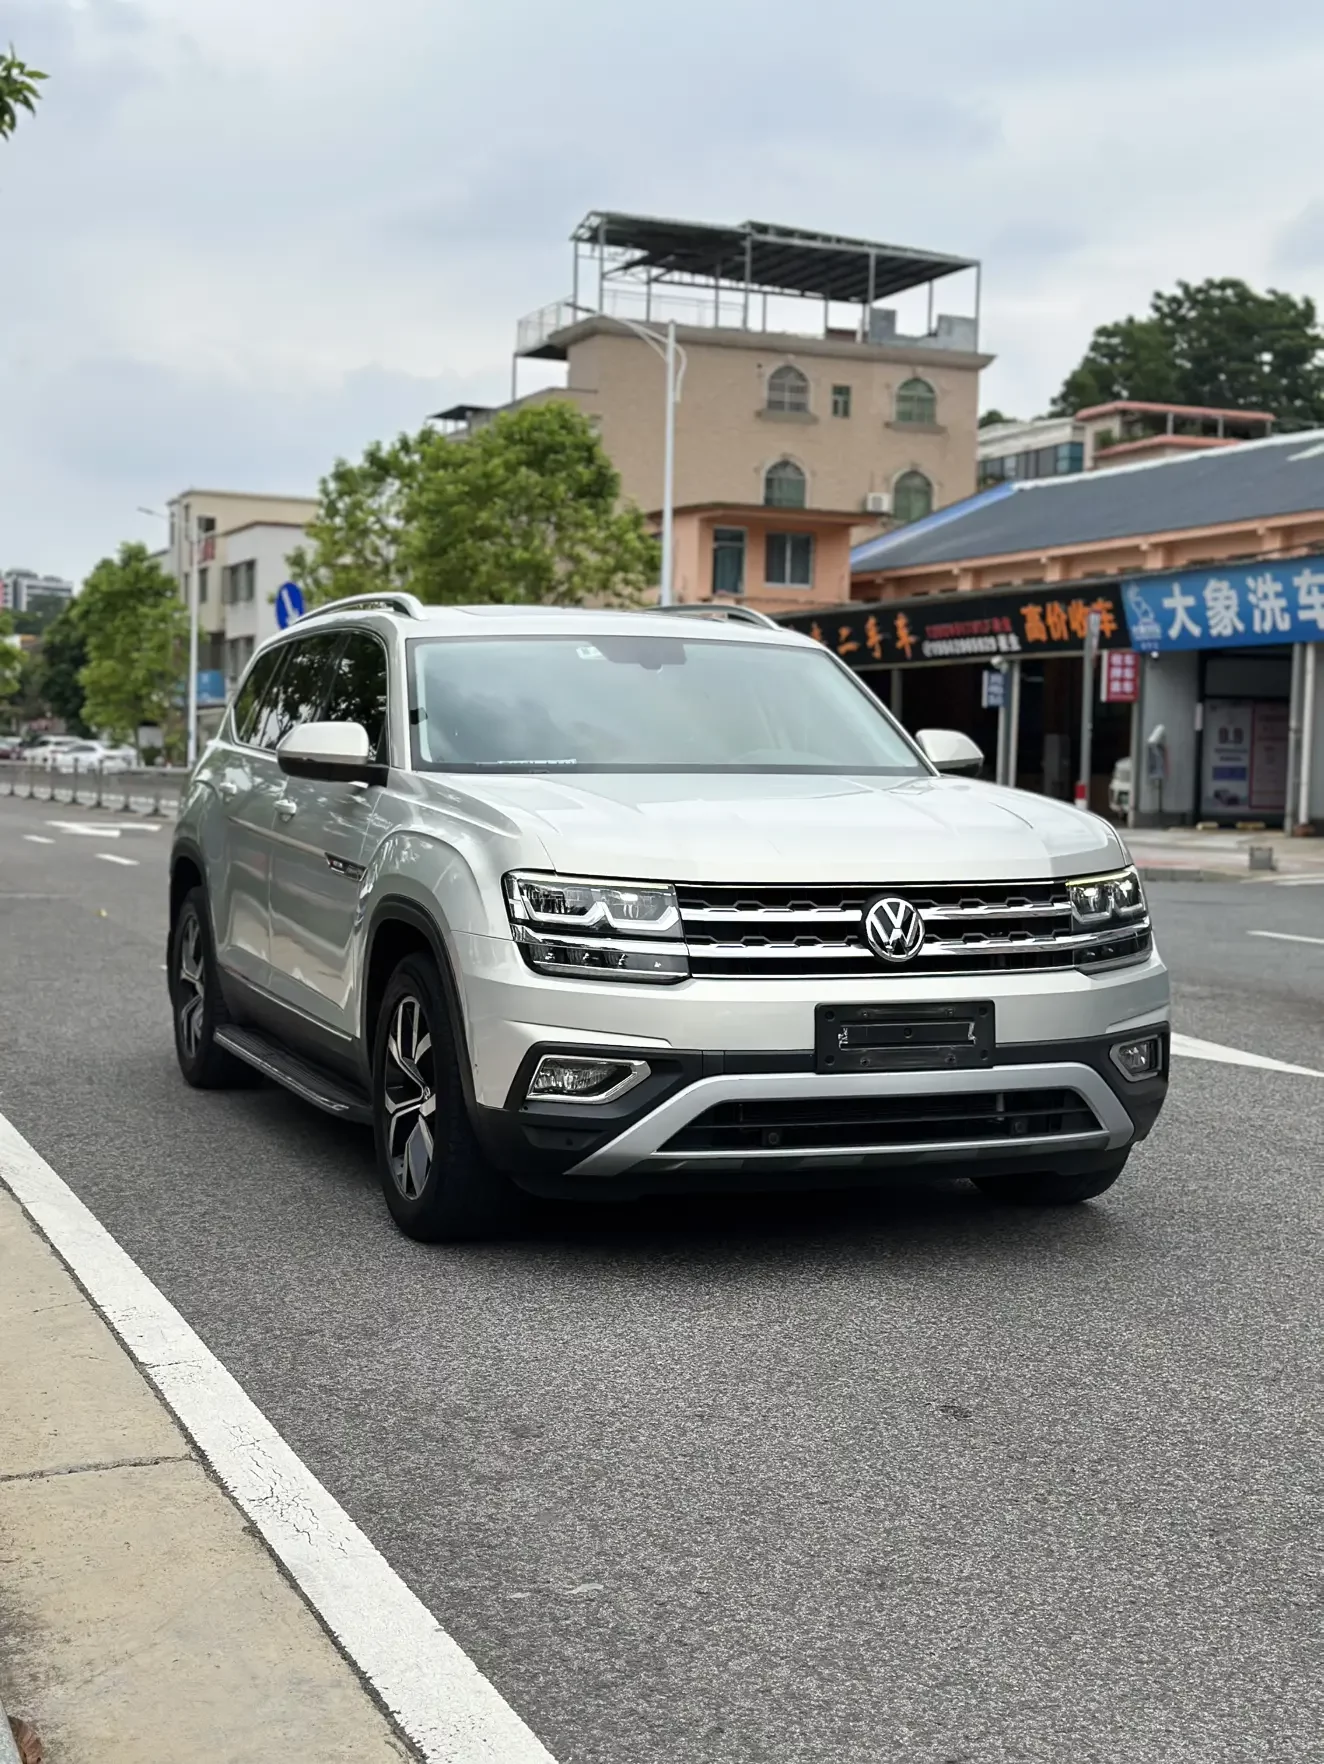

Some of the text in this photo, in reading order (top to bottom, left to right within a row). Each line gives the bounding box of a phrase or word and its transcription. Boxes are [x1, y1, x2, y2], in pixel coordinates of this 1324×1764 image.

[1020, 597, 1118, 643] 高价收车
[1162, 568, 1324, 641] 大象洗车
[866, 897, 925, 962] VW
